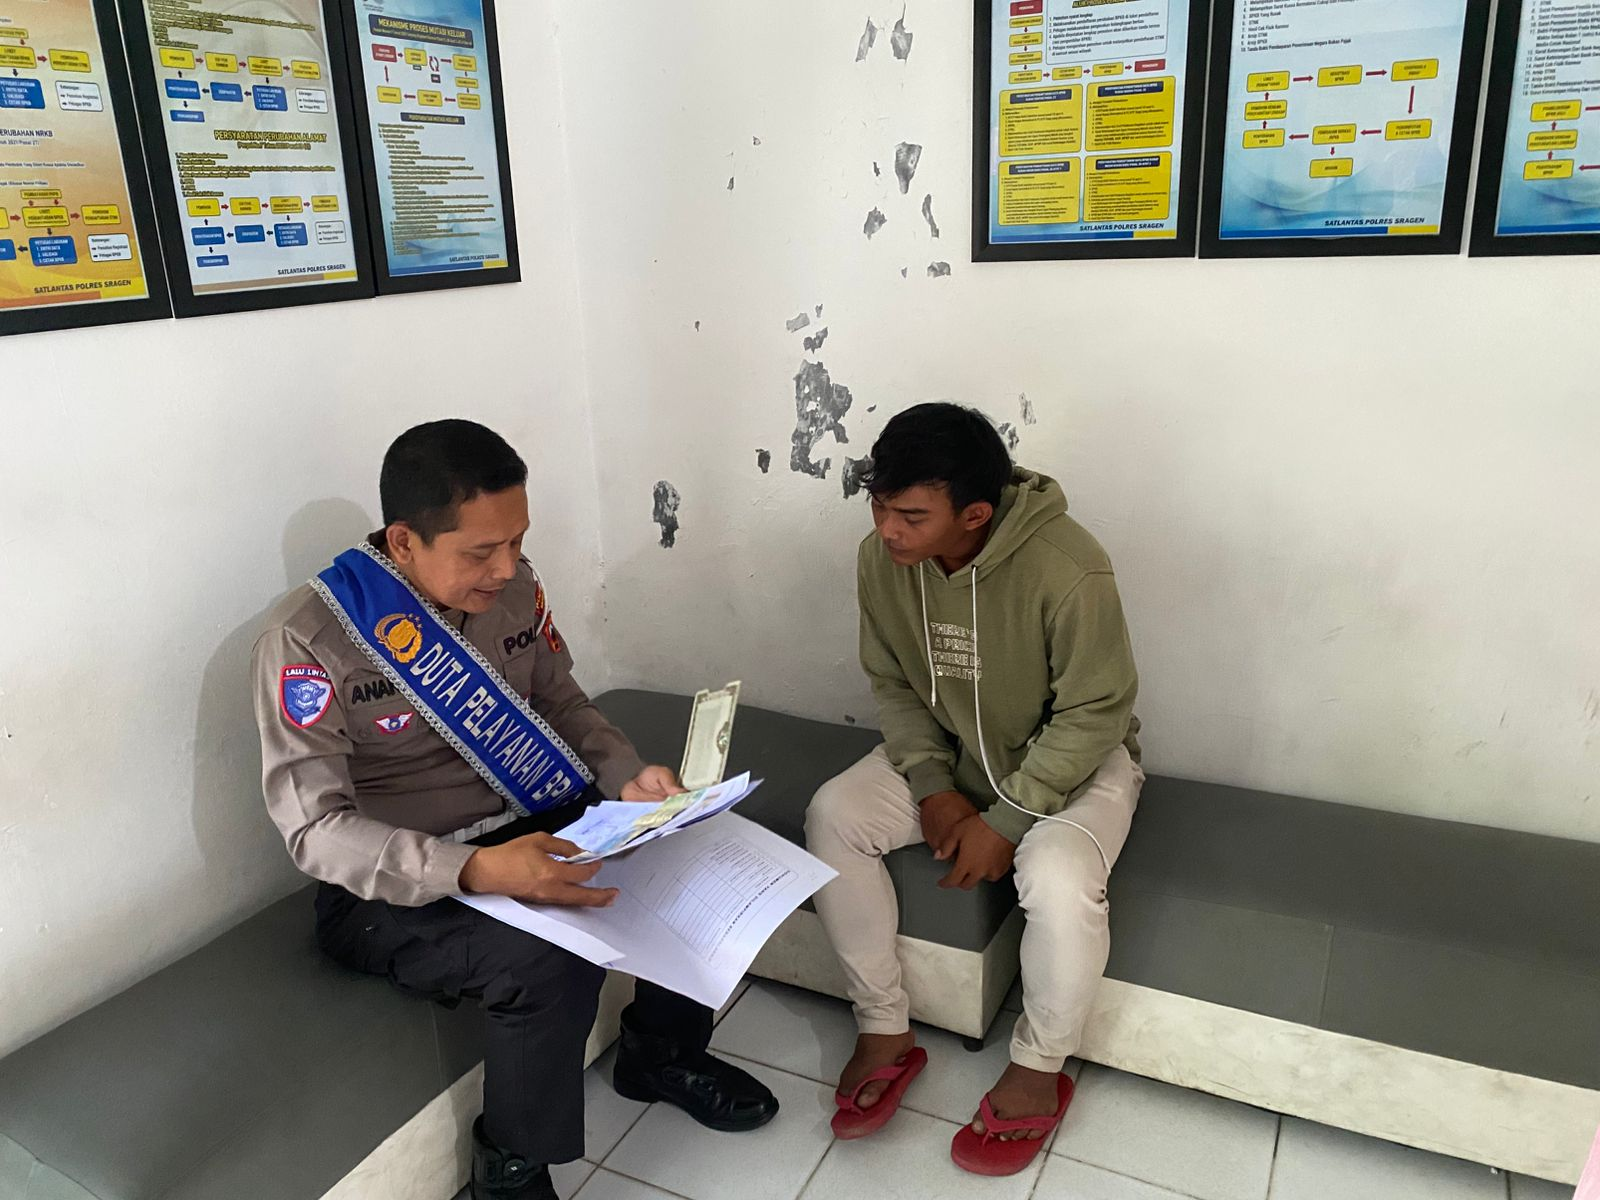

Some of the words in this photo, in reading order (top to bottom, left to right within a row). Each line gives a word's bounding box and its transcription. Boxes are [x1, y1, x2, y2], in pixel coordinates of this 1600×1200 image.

[378, 19, 409, 30] MEKANISME
[214, 130, 262, 140] PERSYARATAN
[34, 285, 74, 294] SATLANTAS
[76, 282, 102, 290] POLRES
[104, 280, 131, 288] SRAGEN
[410, 642, 471, 707] DUTA
[454, 686, 555, 792] PELAYANAN
